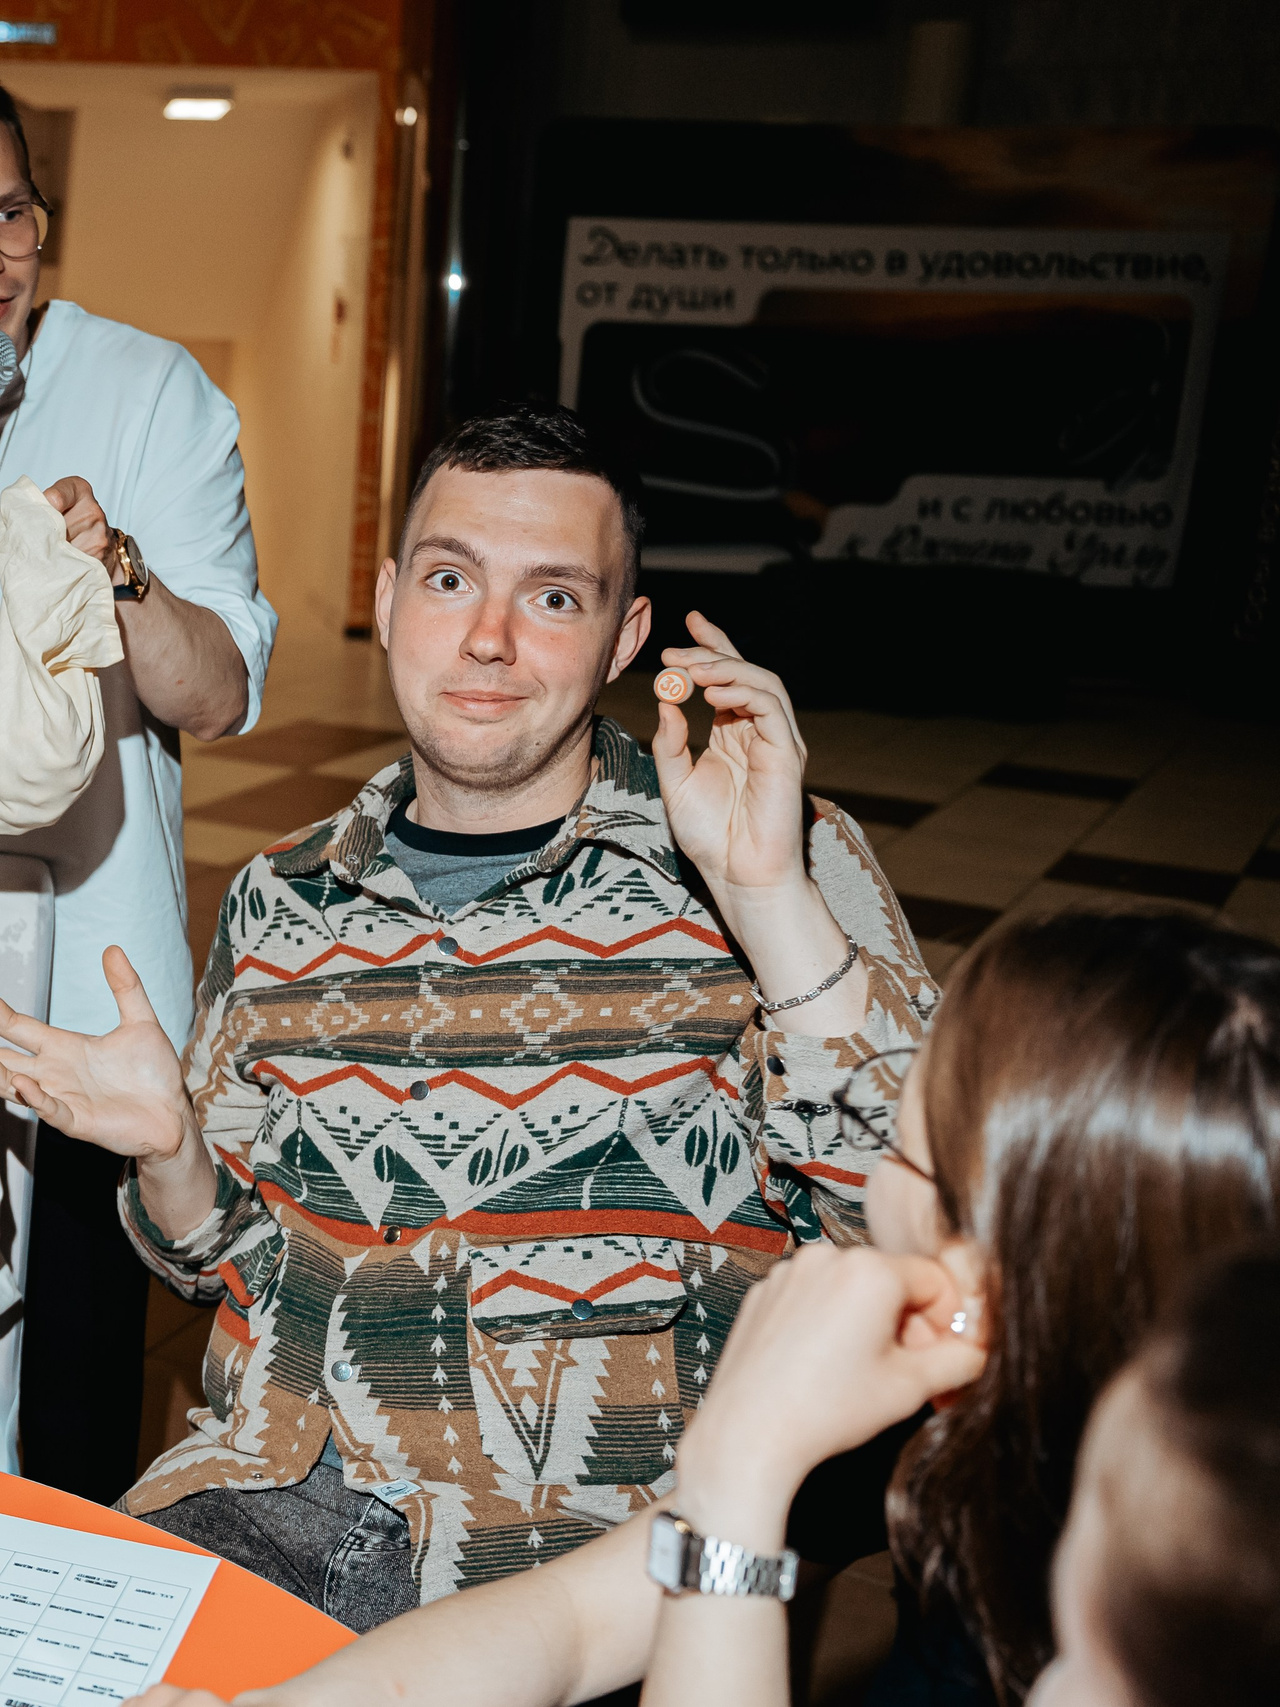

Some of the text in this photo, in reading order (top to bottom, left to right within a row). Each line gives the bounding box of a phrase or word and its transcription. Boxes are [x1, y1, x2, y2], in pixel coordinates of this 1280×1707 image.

[578, 226, 1212, 288] Делать только в удовольствие,
[575, 283, 735, 318] от души
[917, 491, 1174, 531] и с любовью
[660, 675, 682, 697] 30
